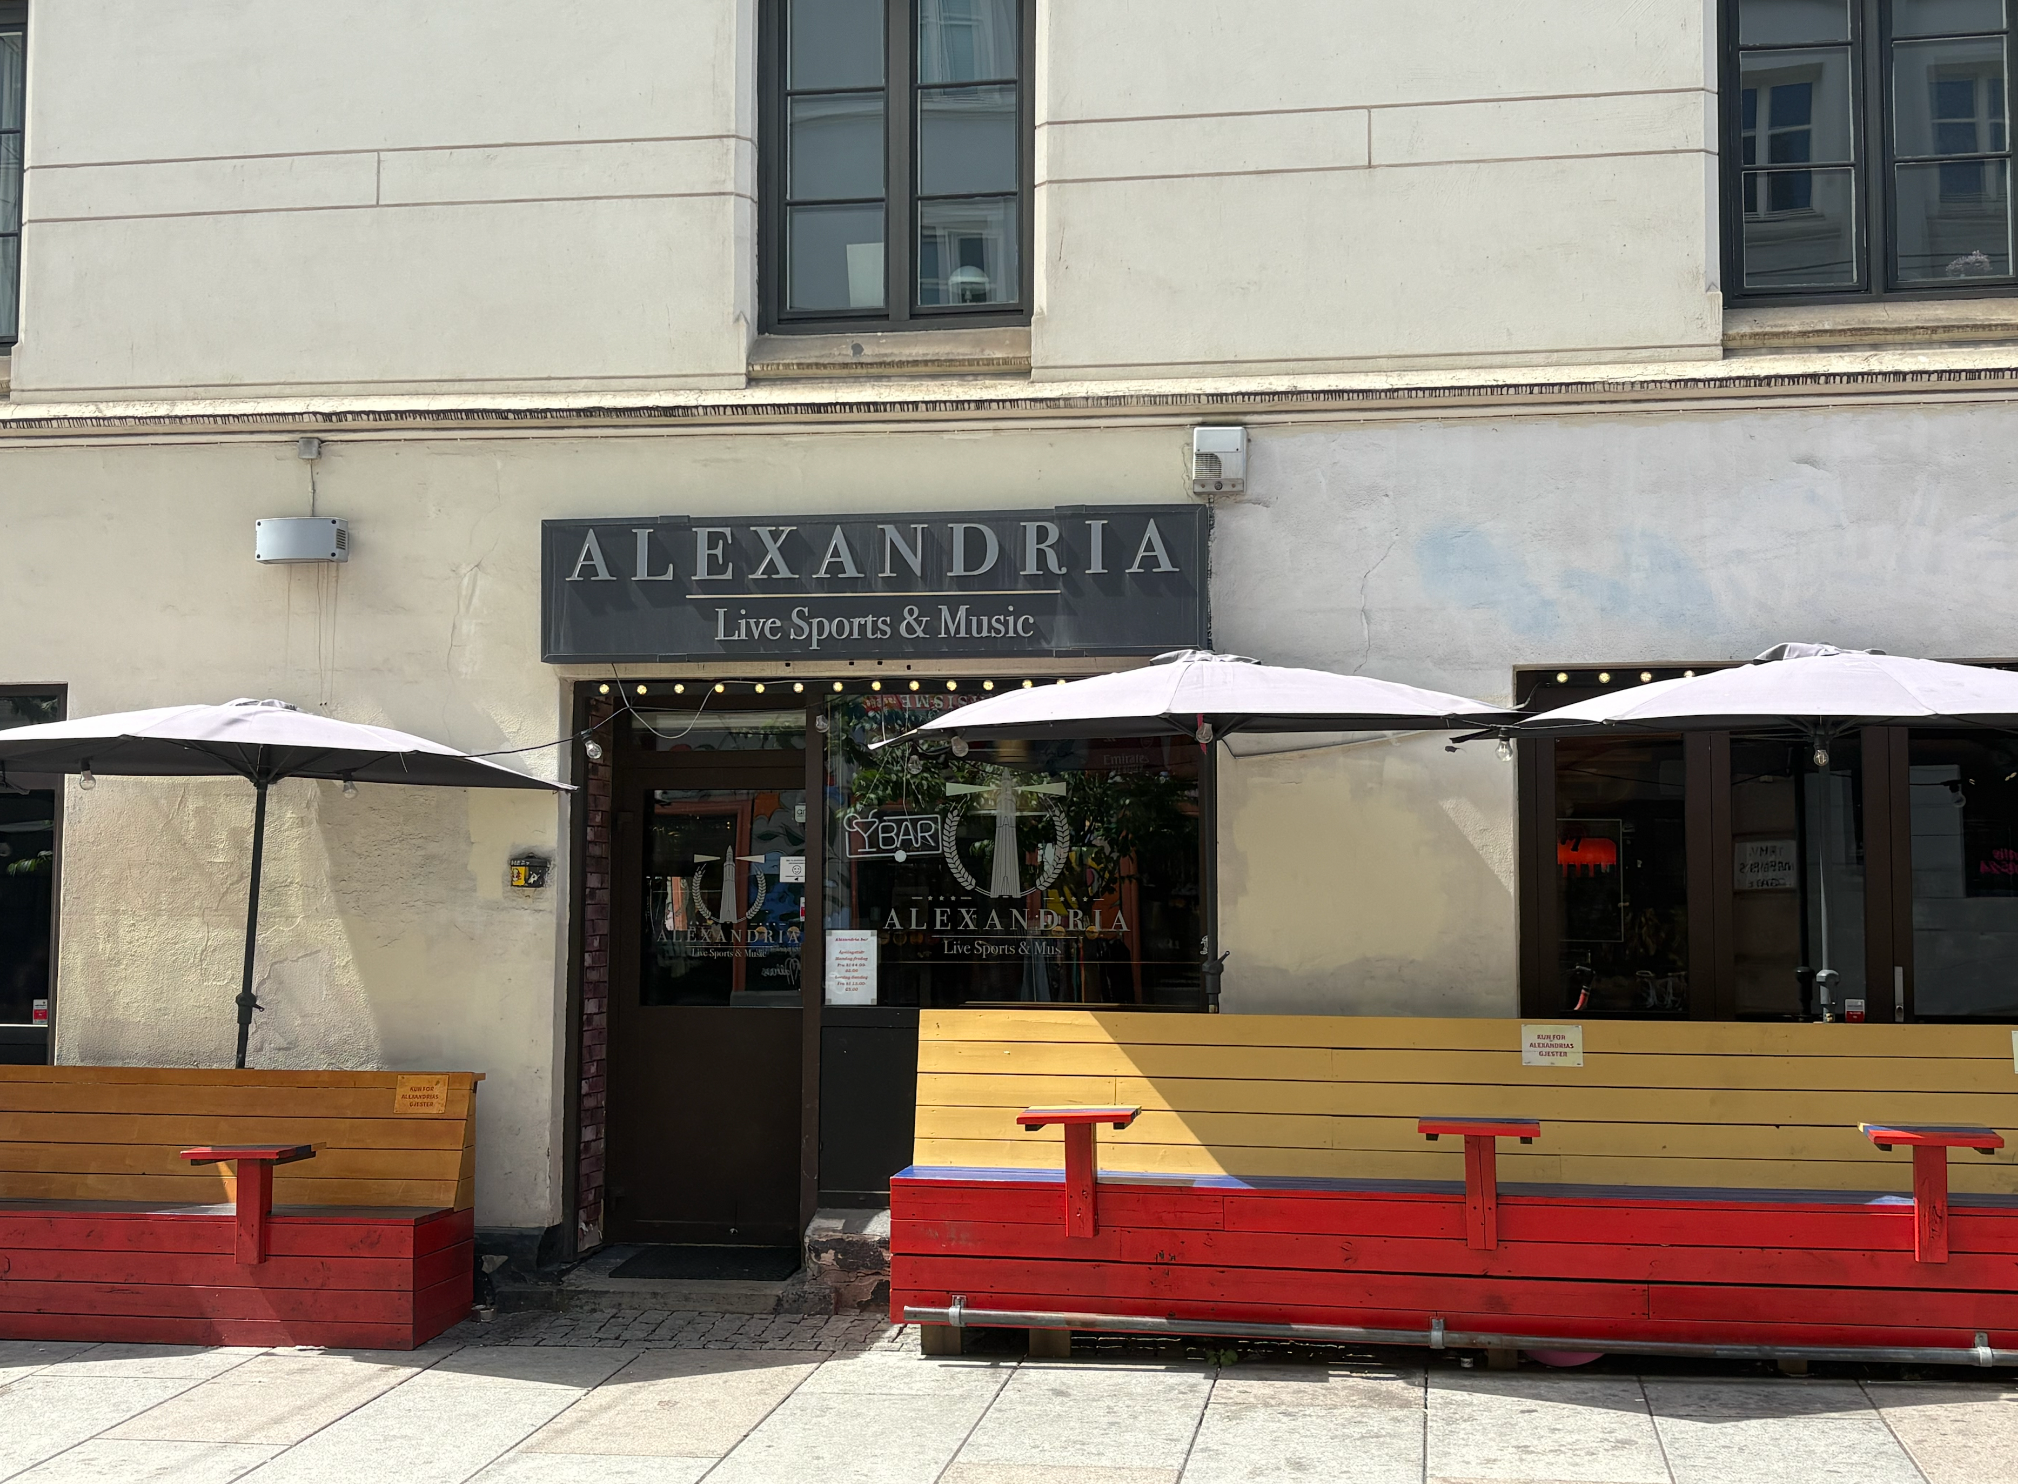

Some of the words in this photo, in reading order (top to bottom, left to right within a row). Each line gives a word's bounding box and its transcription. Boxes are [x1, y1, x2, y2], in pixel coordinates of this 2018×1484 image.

[565, 518, 1180, 582] ALEXANDRIA
[714, 608, 783, 641] Live
[789, 606, 892, 650] Sports
[901, 604, 931, 640] &
[938, 602, 1035, 639] Music
[878, 821, 936, 849] BAR
[883, 907, 1130, 932] ALEXANDRIA
[657, 928, 802, 944] ALEXANDRIA
[691, 948, 708, 958] Live
[709, 948, 734, 960] Sports
[735, 948, 743, 958] &
[744, 948, 767, 958] Music
[943, 940, 971, 955] Live
[974, 940, 1016, 959] Sports
[1018, 940, 1031, 955] &
